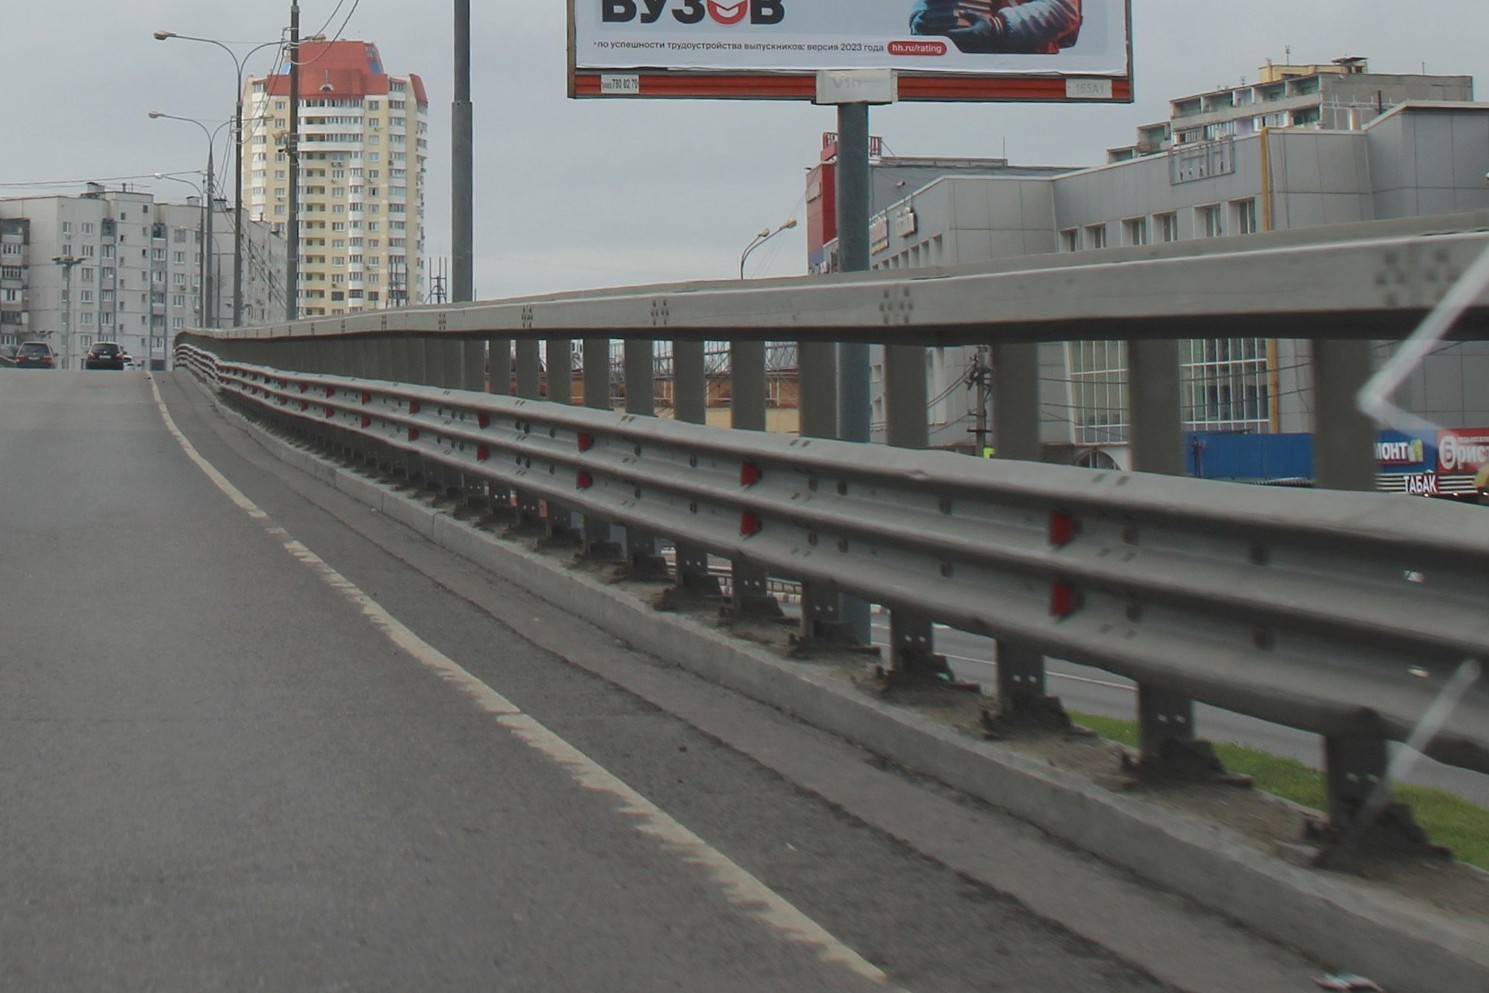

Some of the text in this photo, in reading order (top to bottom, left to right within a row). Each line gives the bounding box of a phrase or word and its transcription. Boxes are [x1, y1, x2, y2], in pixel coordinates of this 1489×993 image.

[610, 41, 665, 50] успешности
[667, 42, 742, 51] трудоустройства
[744, 43, 804, 52] выпускников:
[806, 44, 839, 53] версия
[840, 43, 862, 52] 2023
[863, 45, 884, 53] года
[892, 43, 943, 54] hh.ru/rating
[1402, 474, 1438, 494] ТАБАК
